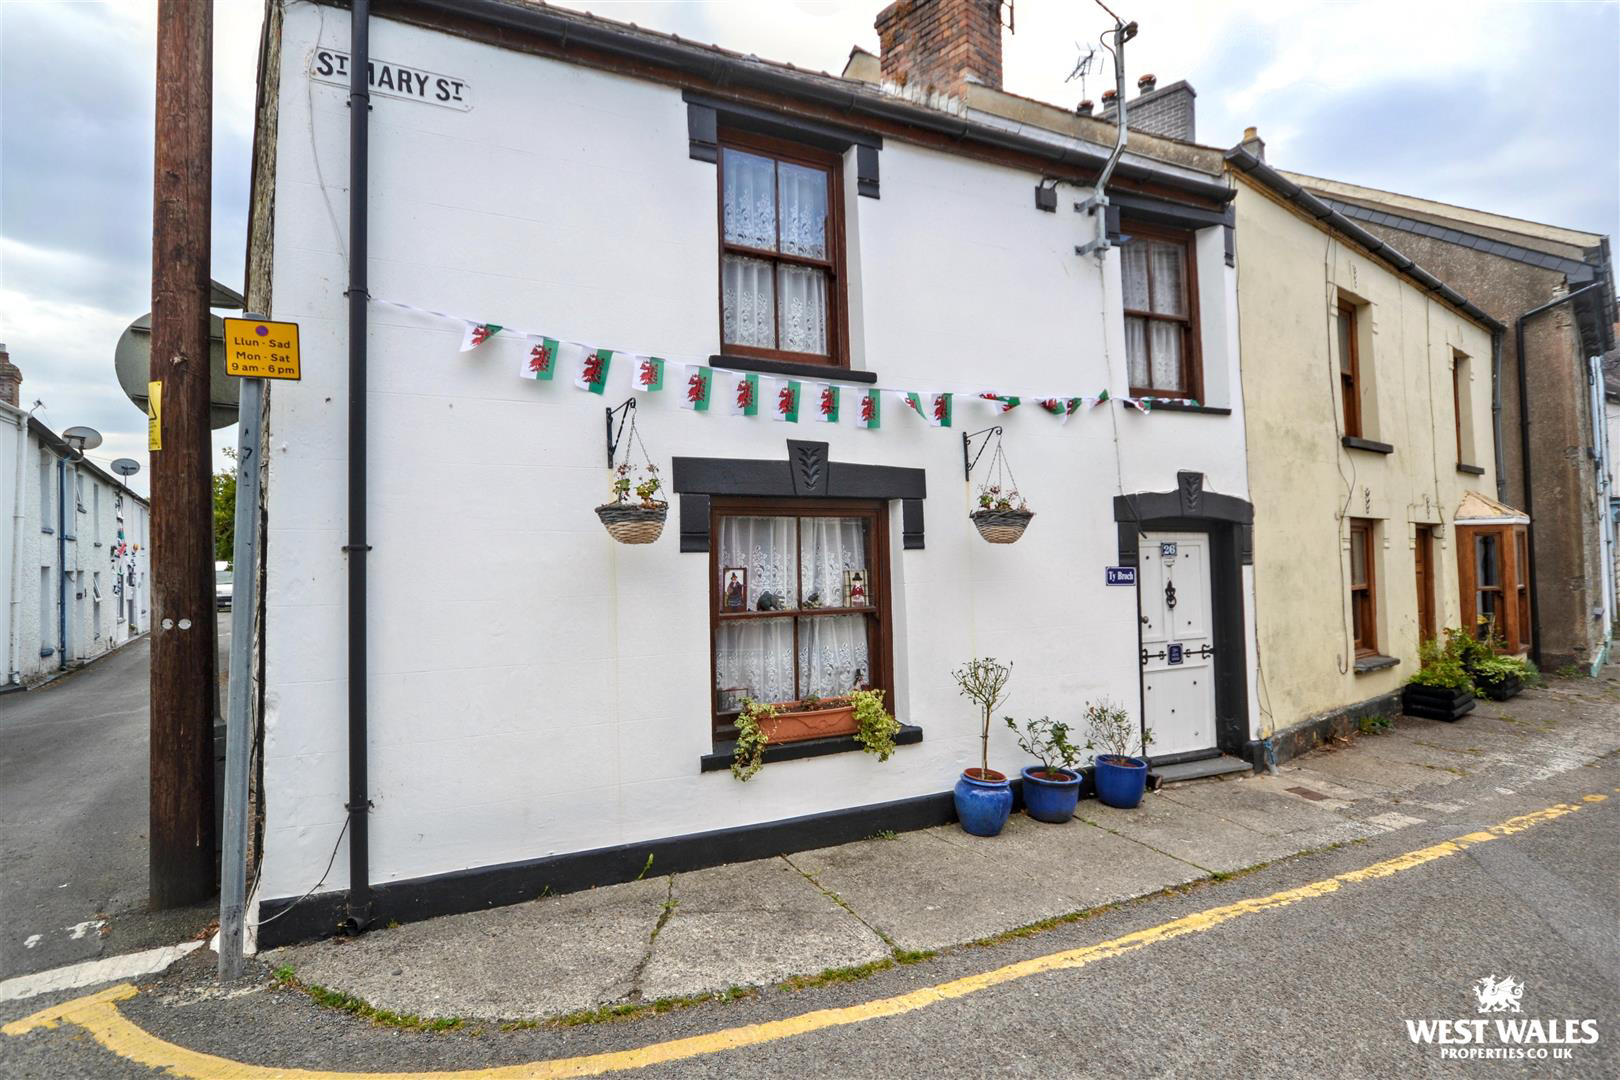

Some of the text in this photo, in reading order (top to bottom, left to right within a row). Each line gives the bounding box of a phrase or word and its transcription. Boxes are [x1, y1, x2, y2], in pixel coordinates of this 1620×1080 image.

[317, 52, 349, 76] ST
[436, 78, 463, 101] ST
[234, 336, 259, 347] Llun
[269, 339, 290, 349] Sad
[236, 351, 261, 360] Mon
[270, 353, 290, 363] Sat
[231, 362, 239, 371] 9
[268, 365, 275, 373] 6
[1163, 544, 1176, 554] 26
[1108, 571, 1116, 582] Ty
